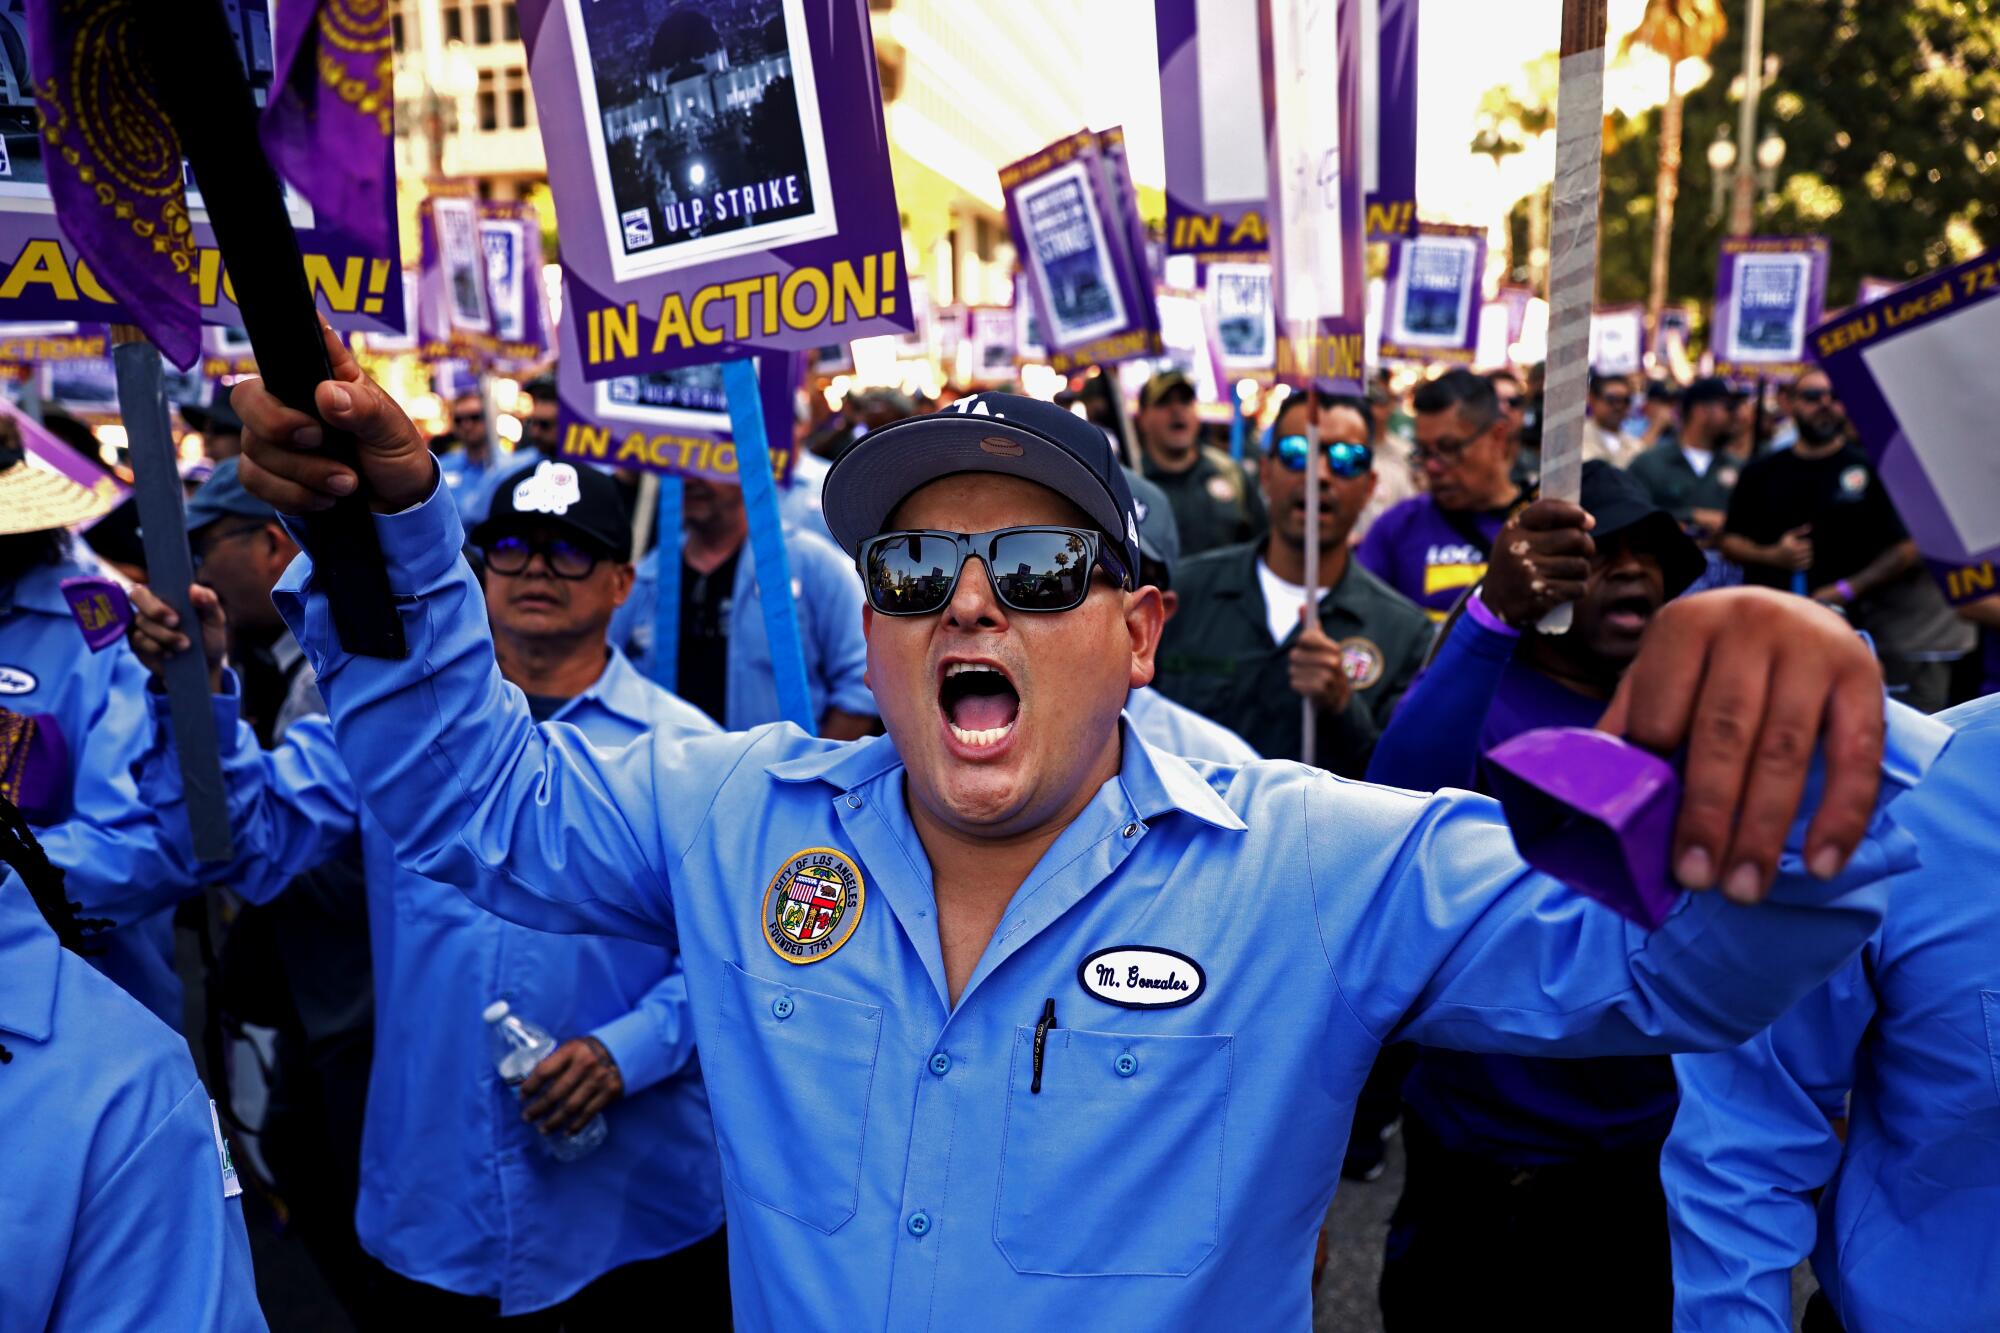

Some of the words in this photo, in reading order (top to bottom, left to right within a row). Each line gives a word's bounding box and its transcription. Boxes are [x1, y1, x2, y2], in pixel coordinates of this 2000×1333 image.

[664, 199, 704, 232] ULP
[714, 174, 800, 221] STRIKE
[1172, 215, 1220, 247] IN
[587, 303, 639, 365] IN
[651, 250, 898, 354] ACTION!
[1816, 312, 1878, 357] SEIU
[1883, 281, 1954, 328] Local
[1959, 258, 2000, 297] 72
[563, 423, 611, 457] IN
[617, 431, 788, 481] ACTIO!
[1947, 559, 1995, 600] IN
[774, 868, 793, 892] CITY
[795, 857, 809, 871] OF
[812, 855, 834, 867] LOS
[834, 862, 858, 908] ANGELES
[768, 922, 804, 956] FOUNDED
[808, 937, 834, 955] 1781
[1095, 963, 1120, 988] M.
[1126, 965, 1190, 992] Gonzales
